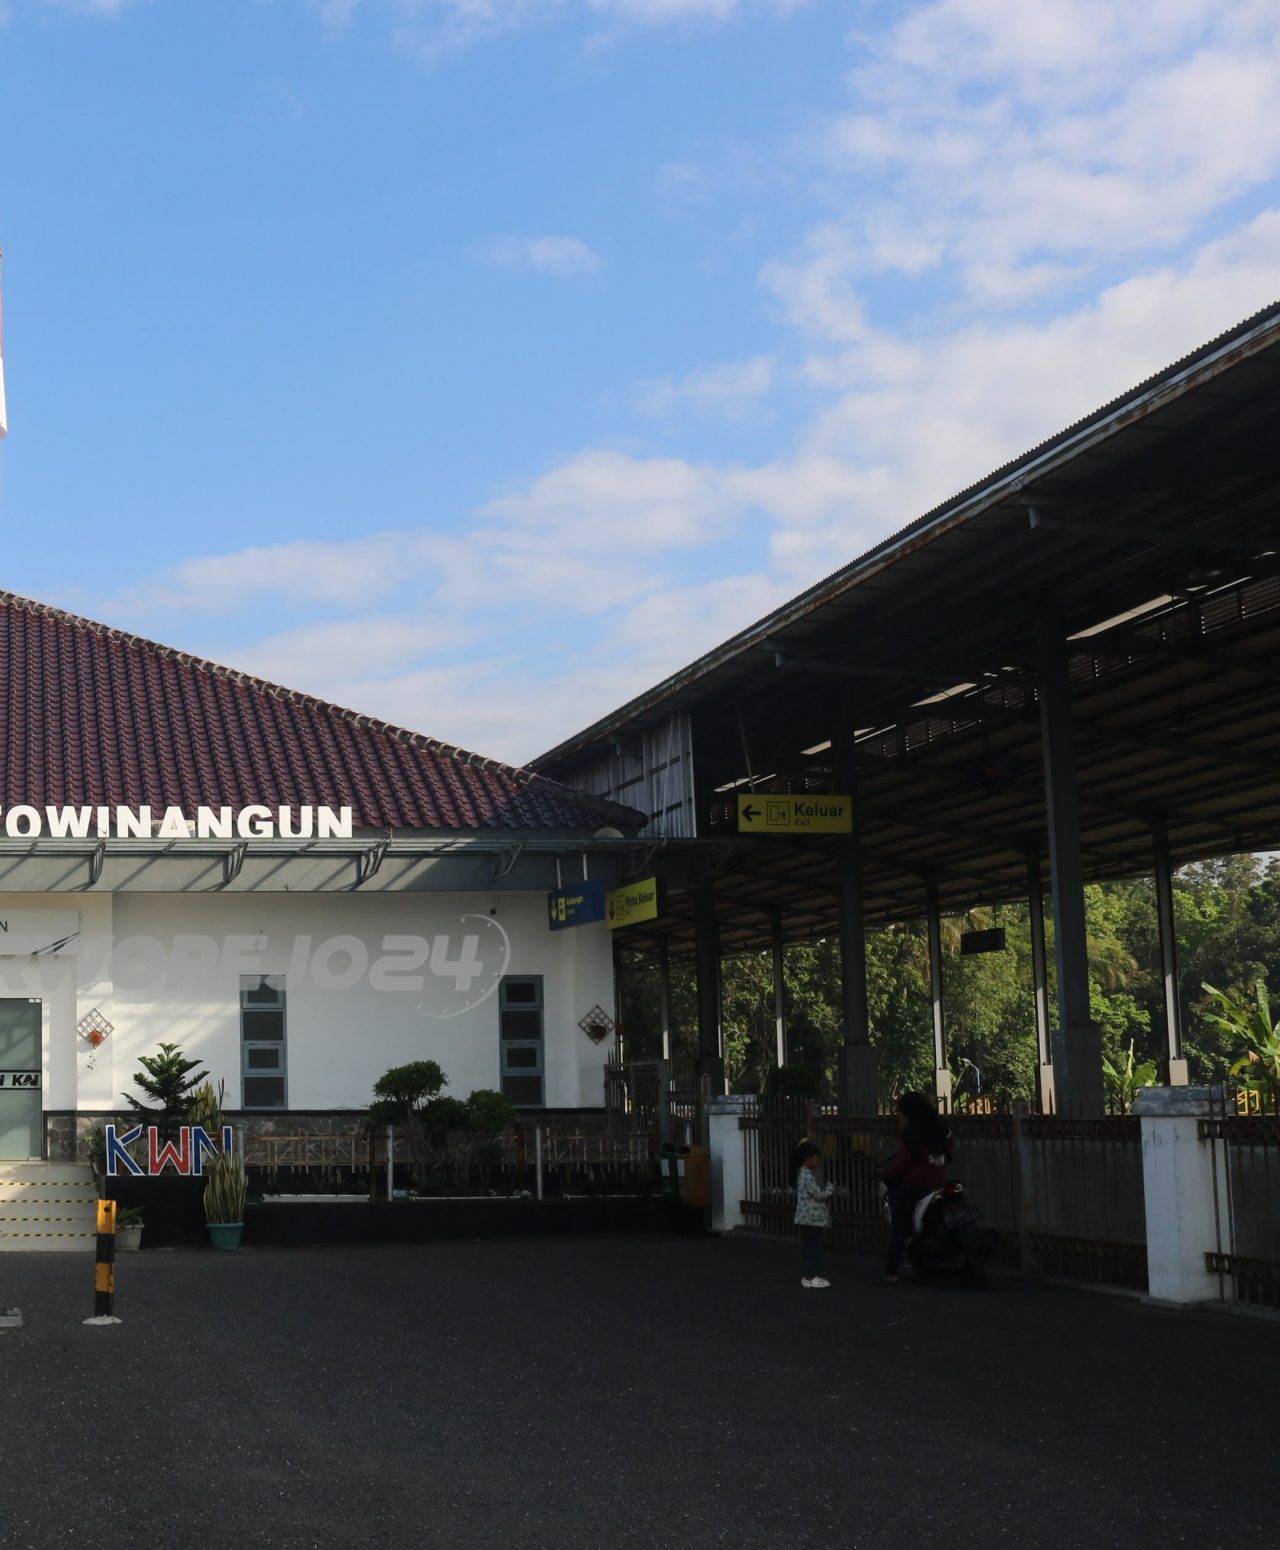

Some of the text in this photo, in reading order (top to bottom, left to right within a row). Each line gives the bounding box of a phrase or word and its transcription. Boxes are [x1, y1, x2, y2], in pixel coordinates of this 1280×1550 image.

[794, 802, 844, 817] Keluar
[12, 1074, 39, 1086] KAI
[105, 1123, 233, 1177] KWN
